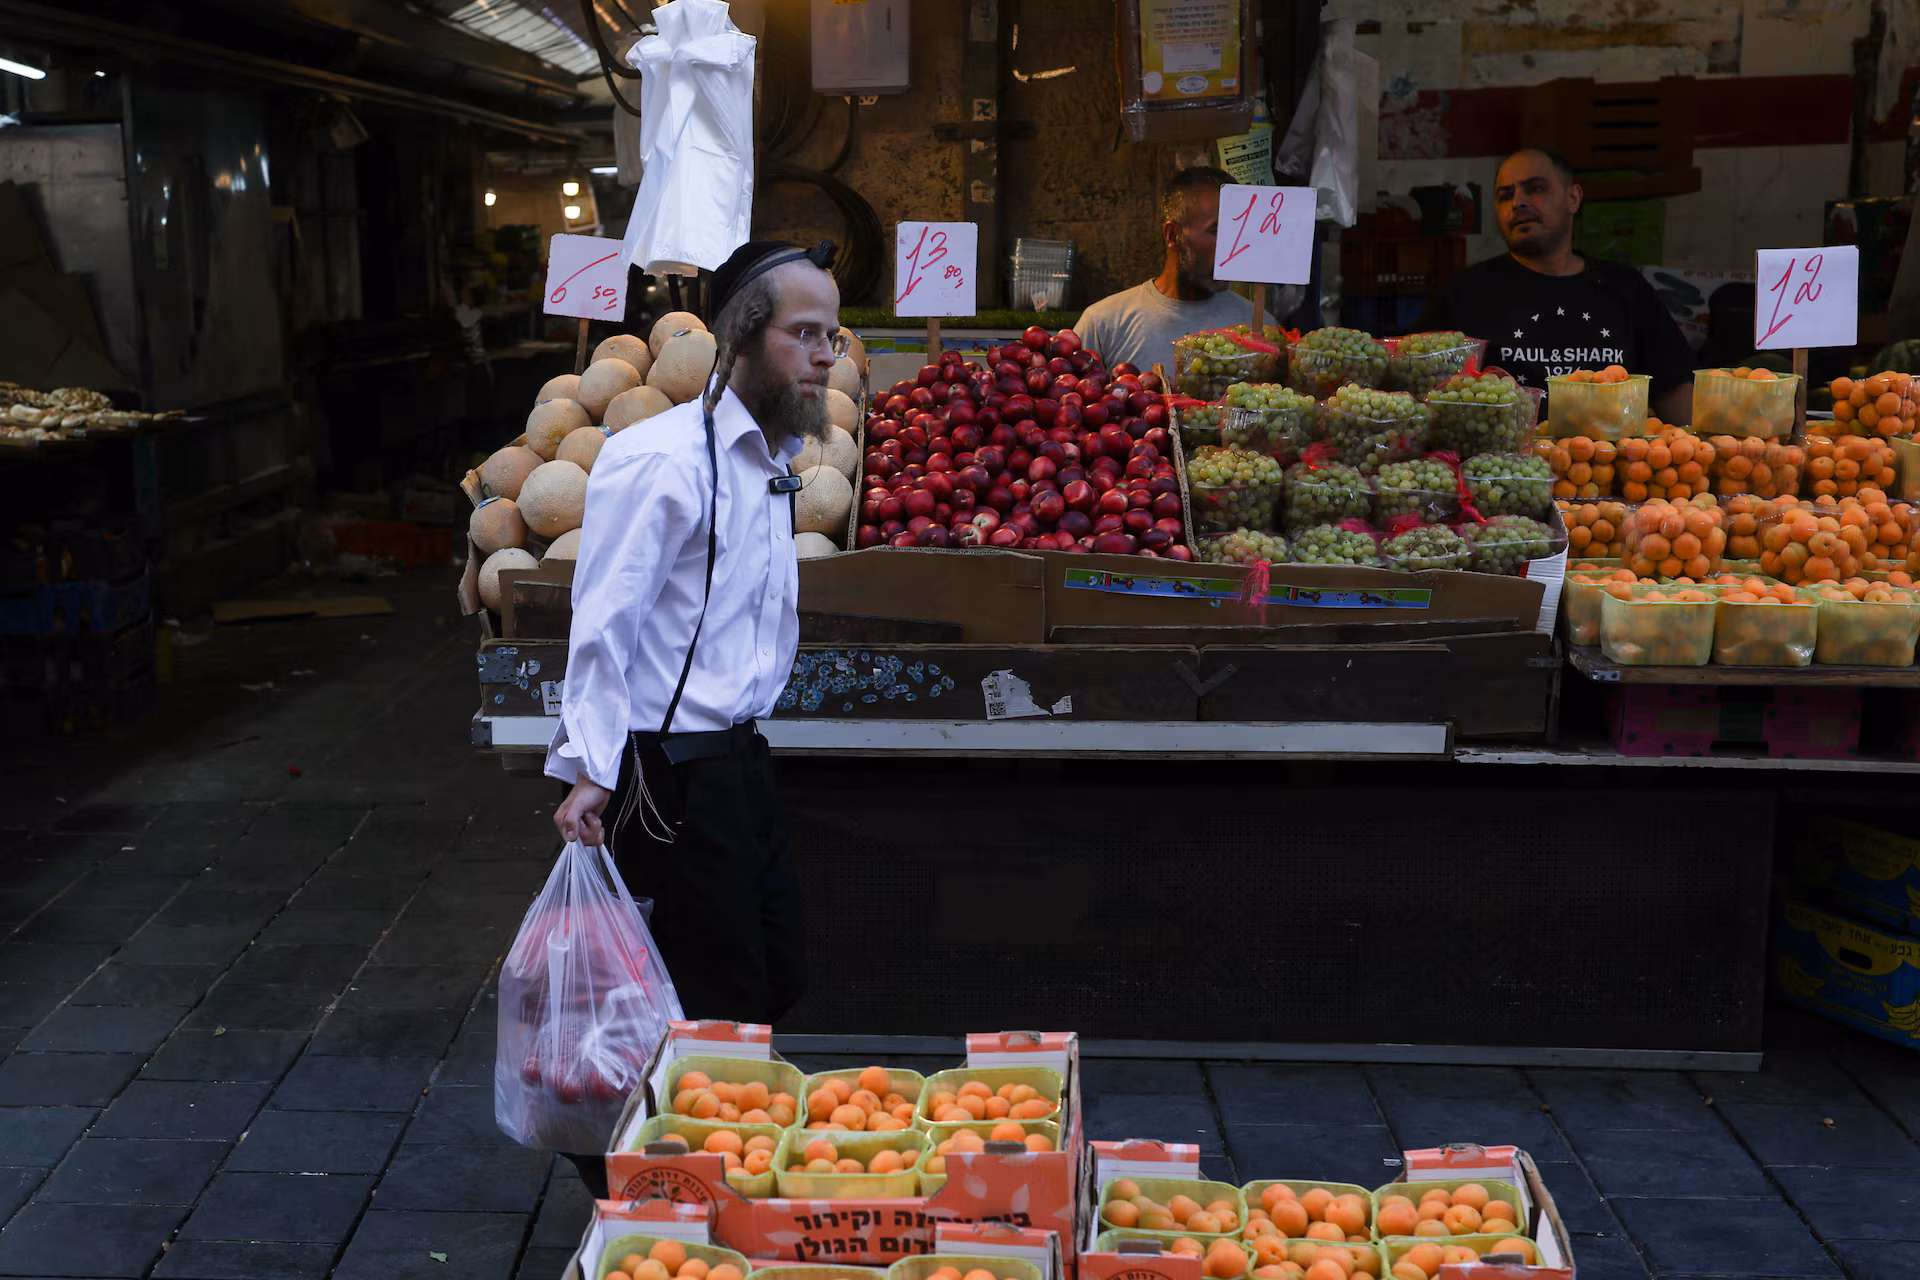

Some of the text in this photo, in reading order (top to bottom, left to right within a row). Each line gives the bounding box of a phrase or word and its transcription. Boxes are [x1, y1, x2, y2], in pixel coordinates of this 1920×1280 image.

[1219, 192, 1284, 267] 12
[550, 252, 618, 304] 6
[896, 226, 948, 304] 13
[1756, 253, 1823, 346] 12
[1500, 347, 1624, 363] PAUL&SHARK
[794, 1210, 882, 1231] וקירור
[794, 1236, 868, 1262] הגולן
